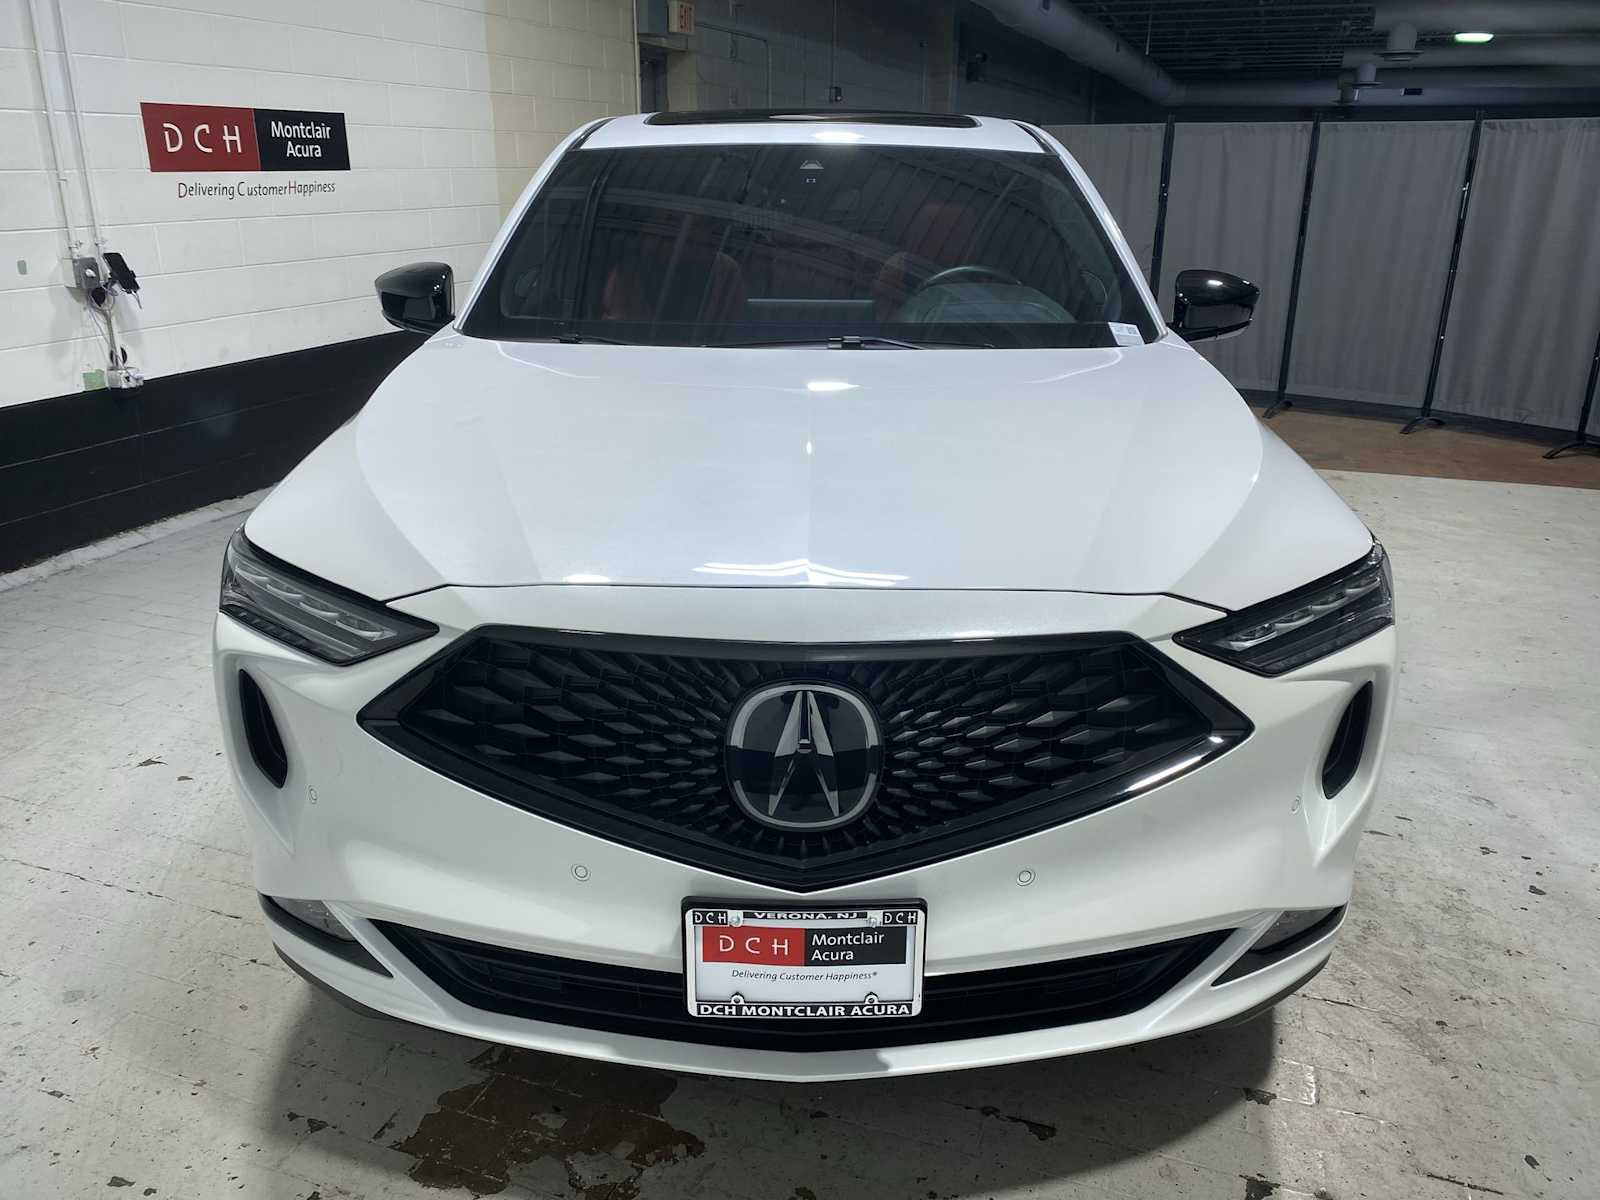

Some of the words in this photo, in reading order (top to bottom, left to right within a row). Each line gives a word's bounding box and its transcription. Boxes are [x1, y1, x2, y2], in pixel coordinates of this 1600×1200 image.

[271, 120, 331, 139] Montclair
[286, 141, 322, 158] Acura
[178, 182, 235, 200] Delivering
[237, 181, 288, 197] Customer
[288, 180, 336, 199] Happiness
[753, 911, 832, 920] VERONA,
[836, 911, 858, 920] NJ
[811, 931, 885, 946] Montclair
[811, 949, 854, 962] Acura
[731, 969, 777, 982] Delivering
[779, 971, 823, 981] Customer
[700, 1003, 737, 1016] DCH
[741, 1004, 846, 1017] MONTCLAIR
[850, 1003, 911, 1016] ACURA
